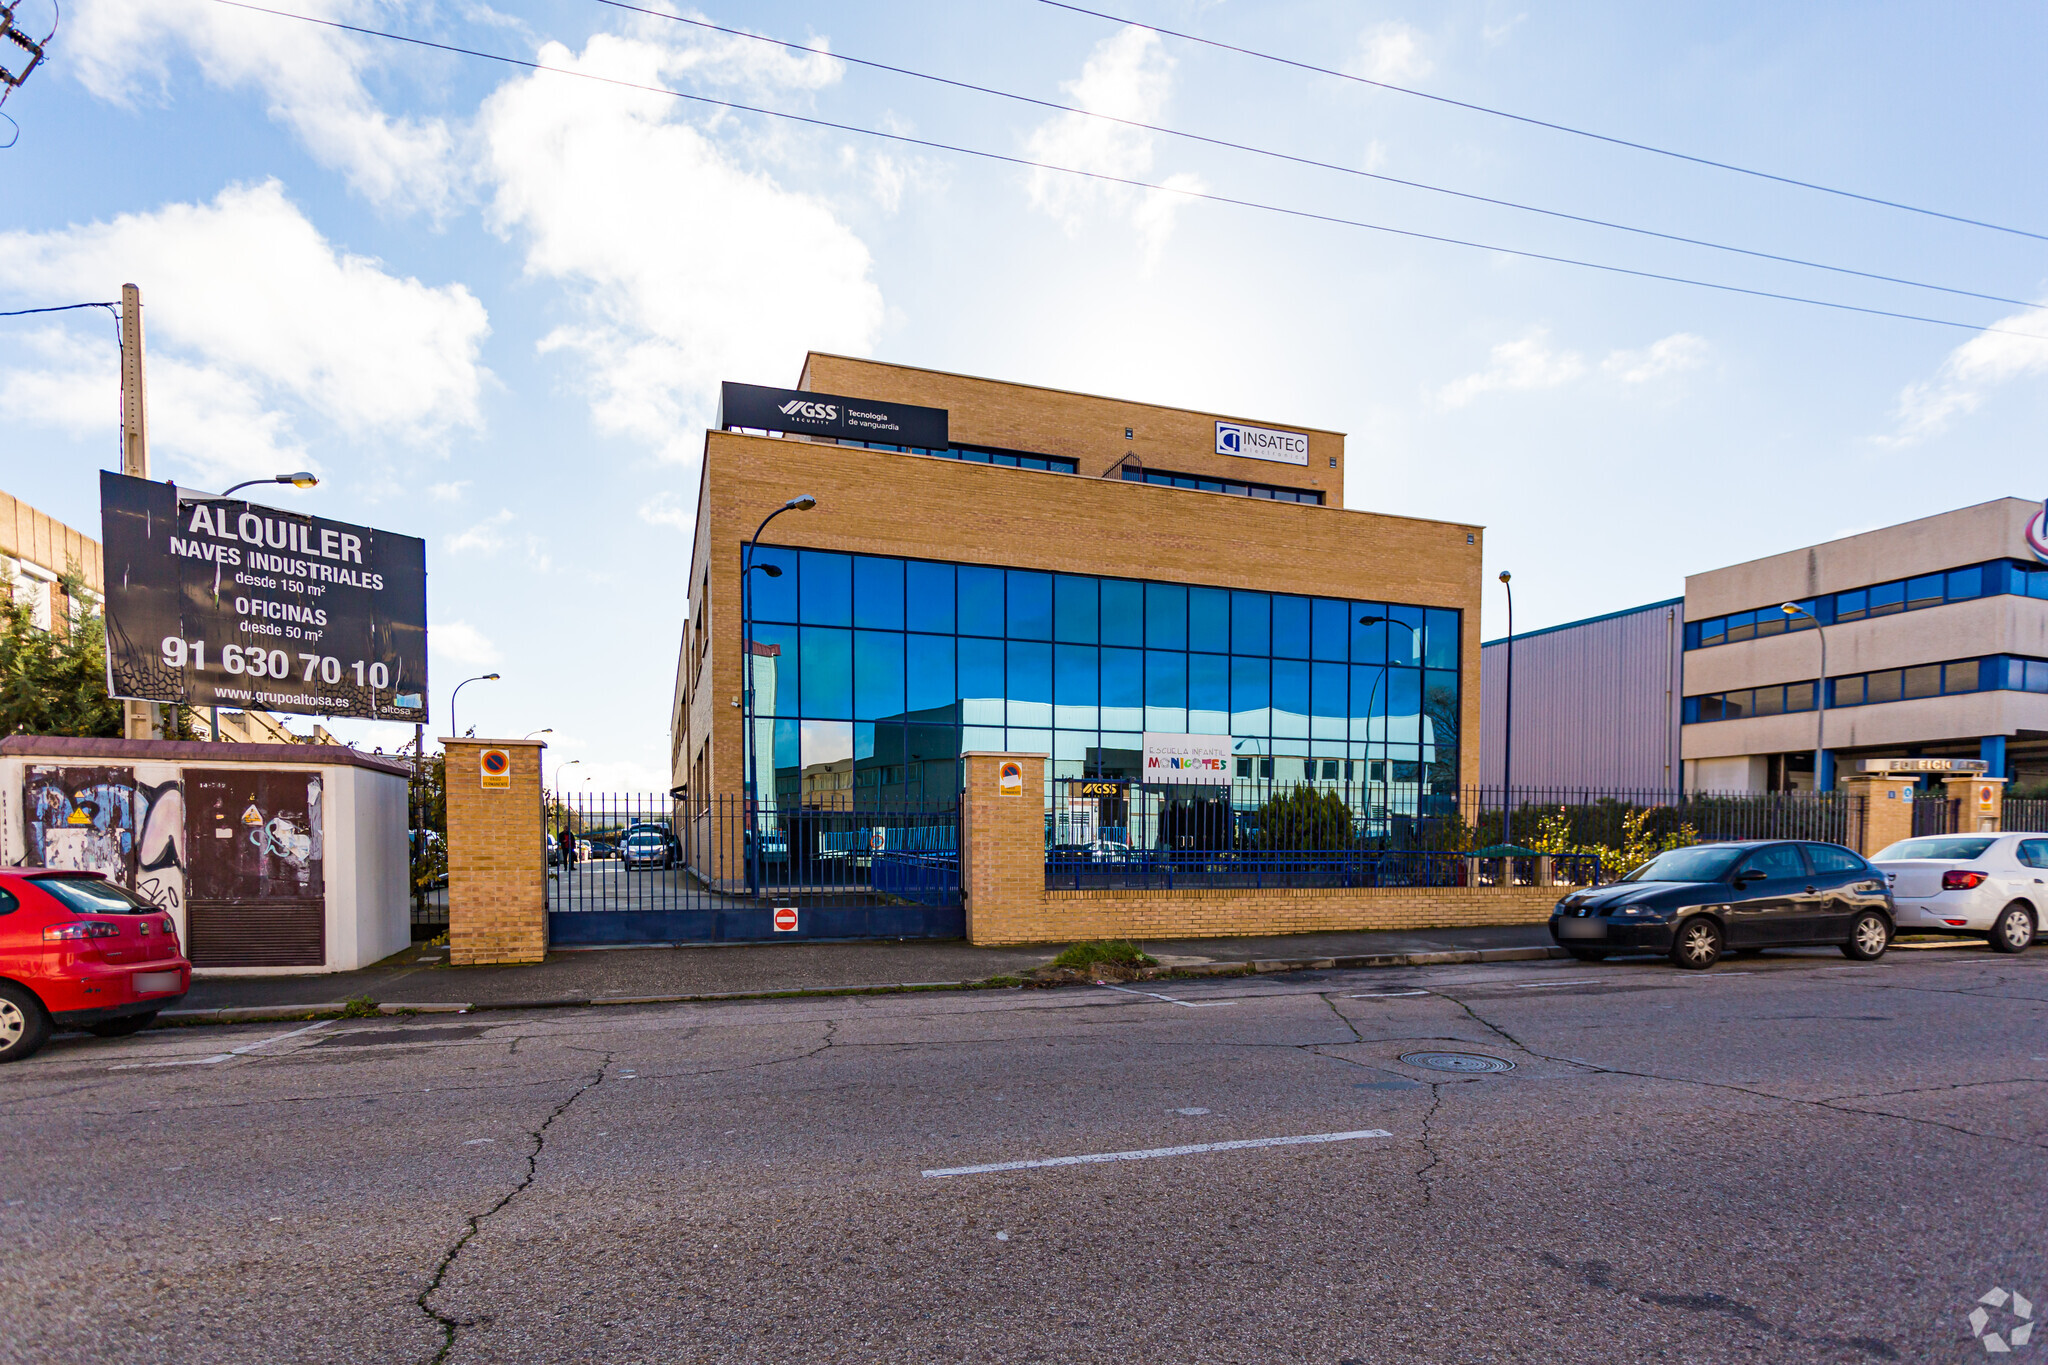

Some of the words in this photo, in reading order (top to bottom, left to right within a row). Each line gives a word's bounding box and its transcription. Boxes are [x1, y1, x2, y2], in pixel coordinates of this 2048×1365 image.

[848, 409, 888, 421] Tecnología
[848, 418, 859, 426] de
[860, 420, 900, 431] vanguardia
[1243, 431, 1305, 453] INSATEC
[188, 504, 363, 564] ALQUILER
[170, 536, 241, 566] NAVES
[250, 551, 384, 591] INDUSTRIALES
[235, 571, 277, 589] desde
[280, 579, 304, 594] 150
[235, 596, 328, 626] OFICINAS
[240, 620, 282, 636] desde
[285, 625, 302, 639] 50
[161, 636, 205, 671] 91
[222, 644, 290, 680] 630
[298, 653, 341, 685] 70
[351, 660, 389, 690] 10
[214, 687, 350, 709] www.grupoaltosa.es
[381, 705, 411, 715] altosa
[1149, 747, 1188, 755] ESCUELA
[1191, 747, 1226, 757] INFANTIL
[1148, 757, 1227, 770] MONIGOTES
